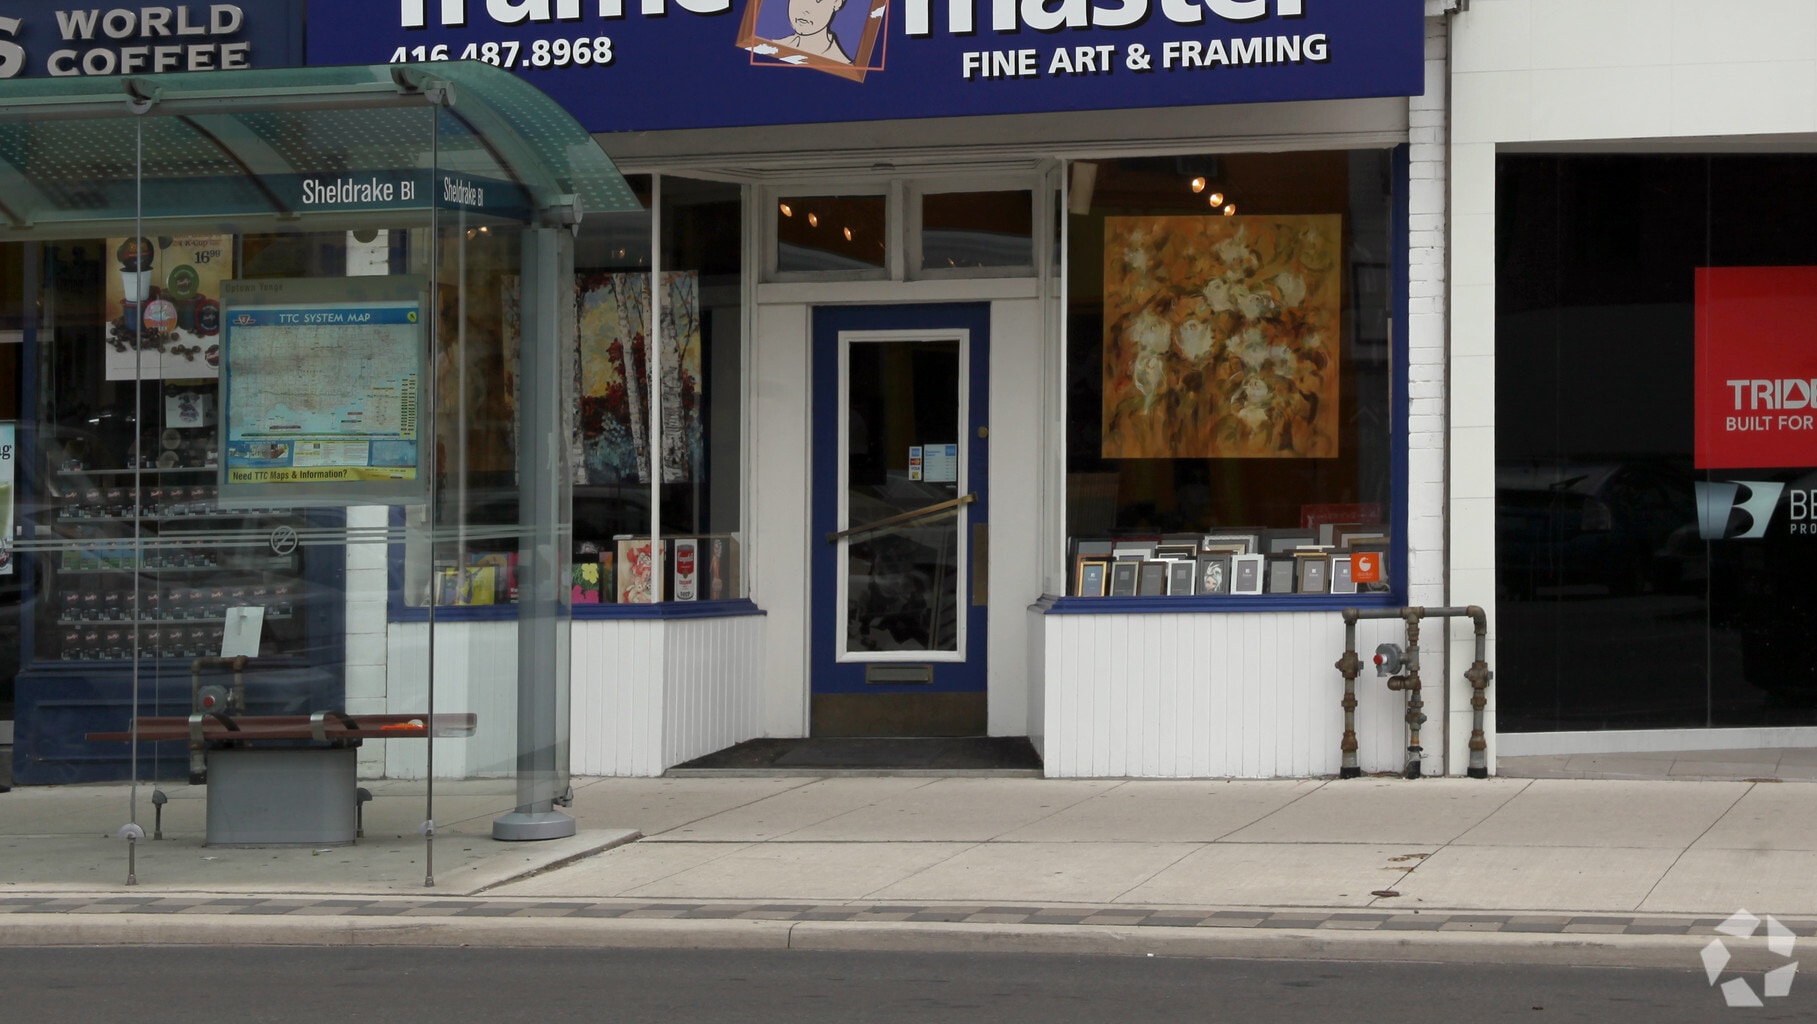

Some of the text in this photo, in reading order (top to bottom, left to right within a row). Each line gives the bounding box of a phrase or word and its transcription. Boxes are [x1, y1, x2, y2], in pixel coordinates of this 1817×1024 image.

[55, 4, 244, 40] WORLD
[47, 41, 251, 76] COFFEE
[390, 37, 613, 68] 416487.8968
[962, 33, 1328, 79] FINE ART & FRAMING
[302, 177, 394, 204] Sheldrake
[443, 177, 477, 206] Sheldrake
[280, 312, 371, 324] TTC SYSTEM MAP
[1726, 415, 1814, 432] BUILT FOR
[233, 471, 253, 481] Need
[254, 470, 268, 480] TTC
[270, 470, 290, 482] Maps
[291, 470, 298, 479] &
[299, 468, 348, 480] Information?
